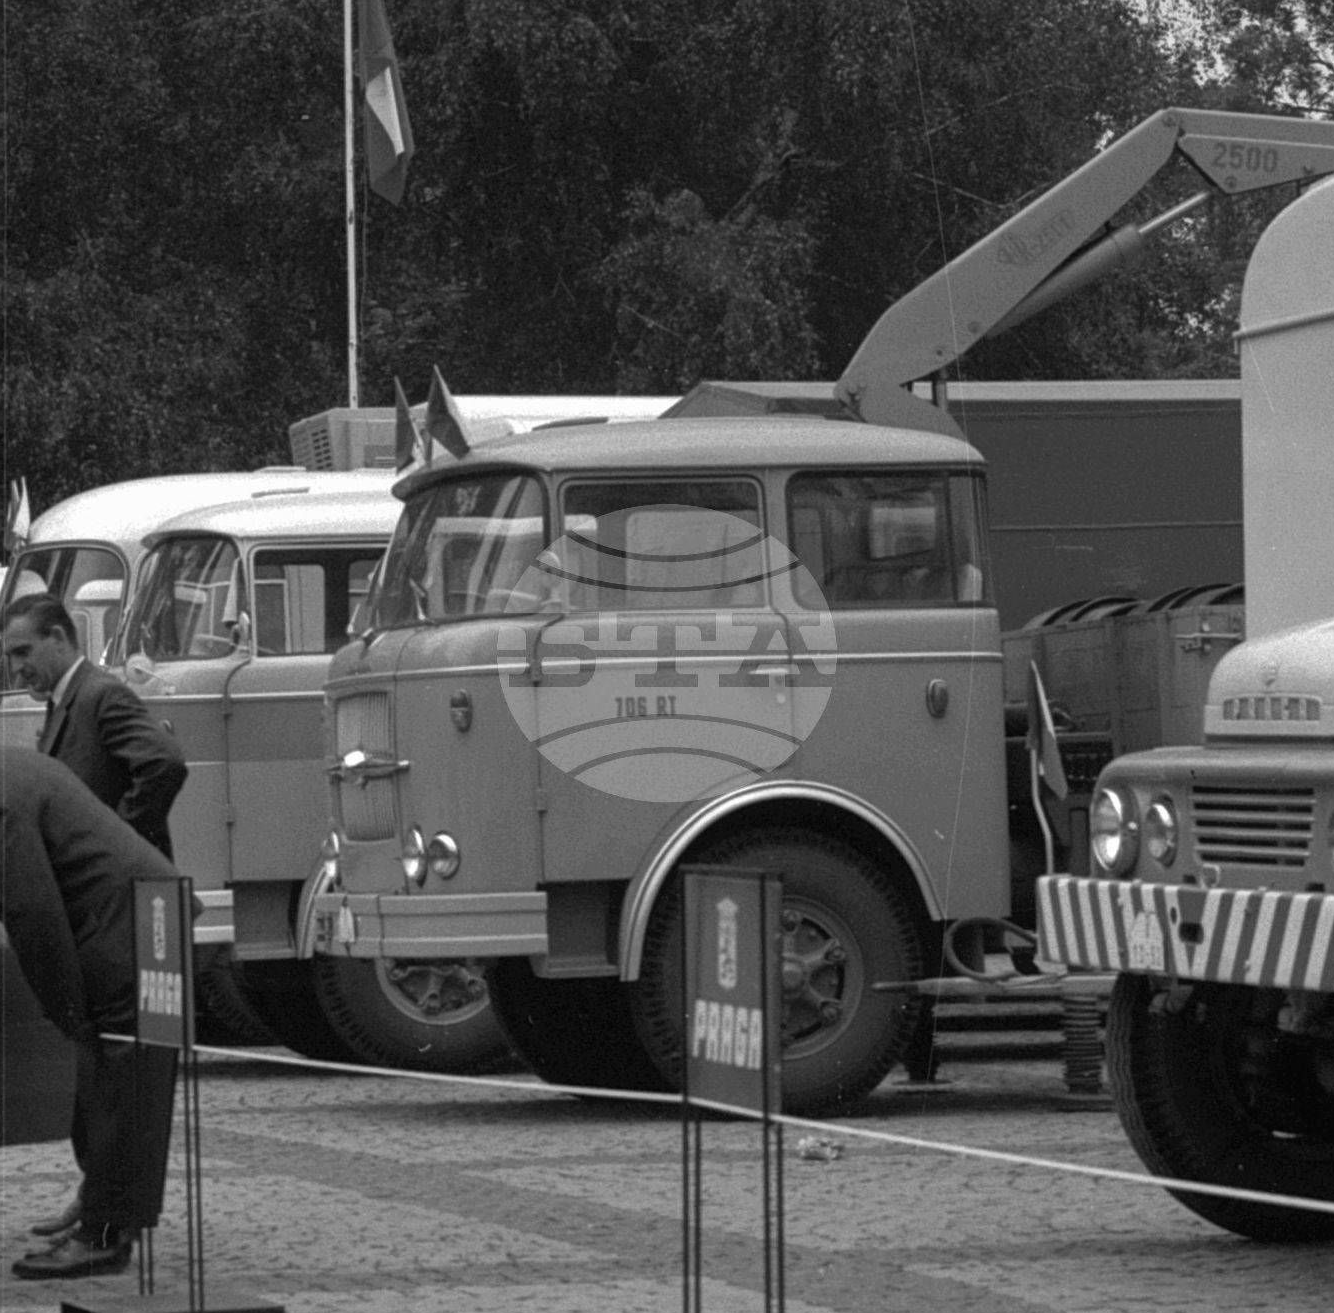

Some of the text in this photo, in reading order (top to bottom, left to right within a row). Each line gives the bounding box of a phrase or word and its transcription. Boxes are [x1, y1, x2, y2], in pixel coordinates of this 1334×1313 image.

[1212, 142, 1279, 173] 2500
[656, 695, 677, 717] RT
[692, 999, 763, 1070] PRAGA
